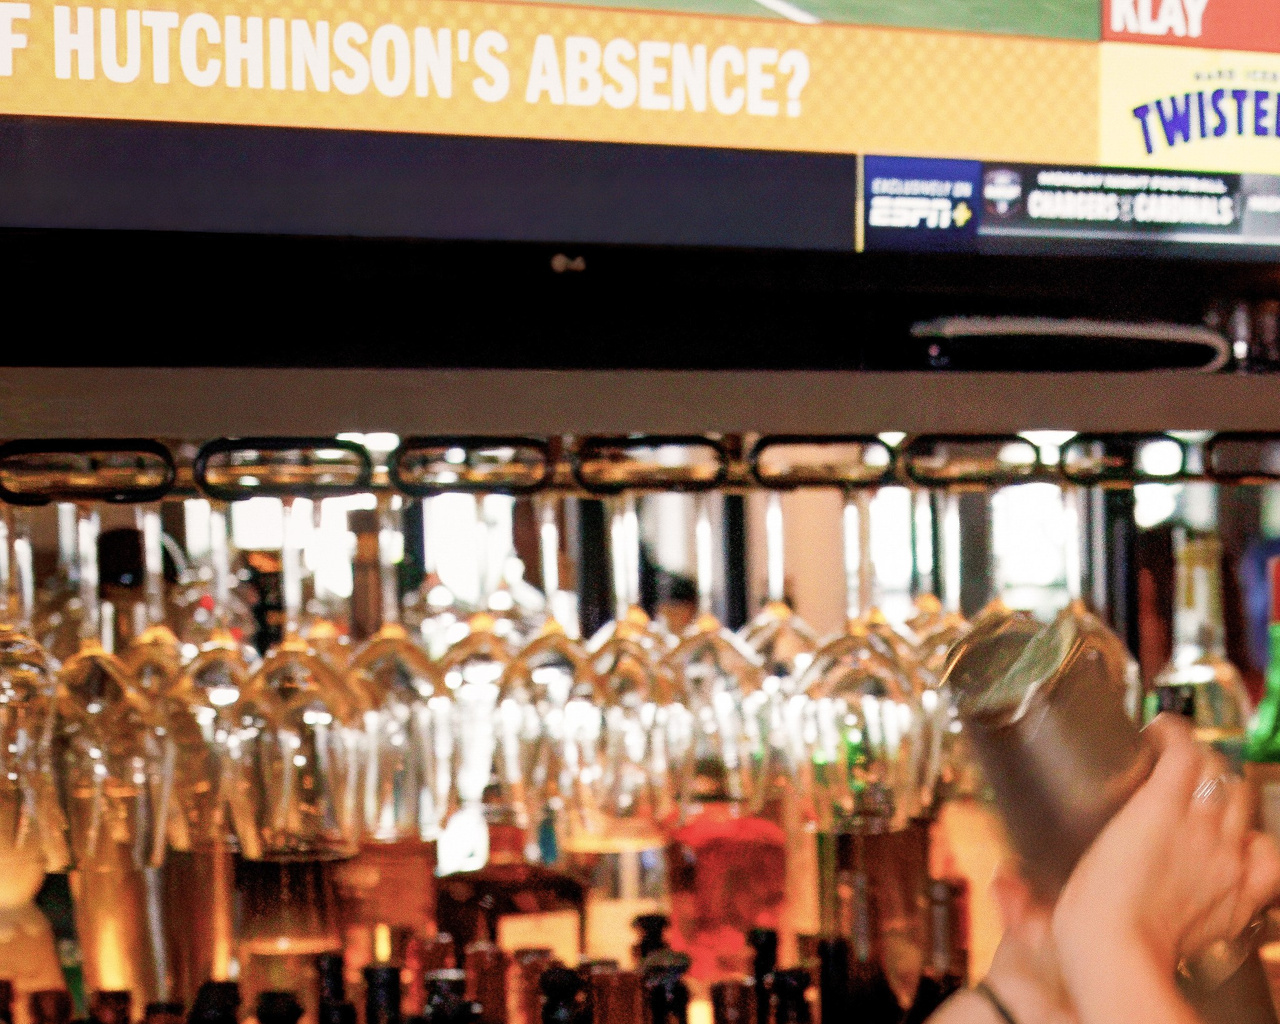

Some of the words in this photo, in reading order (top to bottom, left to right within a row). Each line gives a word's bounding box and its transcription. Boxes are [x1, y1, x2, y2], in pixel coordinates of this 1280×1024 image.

[1110, 0, 1207, 38] KLAY
[53, 6, 510, 102] HUTCHINSON'S
[525, 34, 810, 118] ABSENCE?
